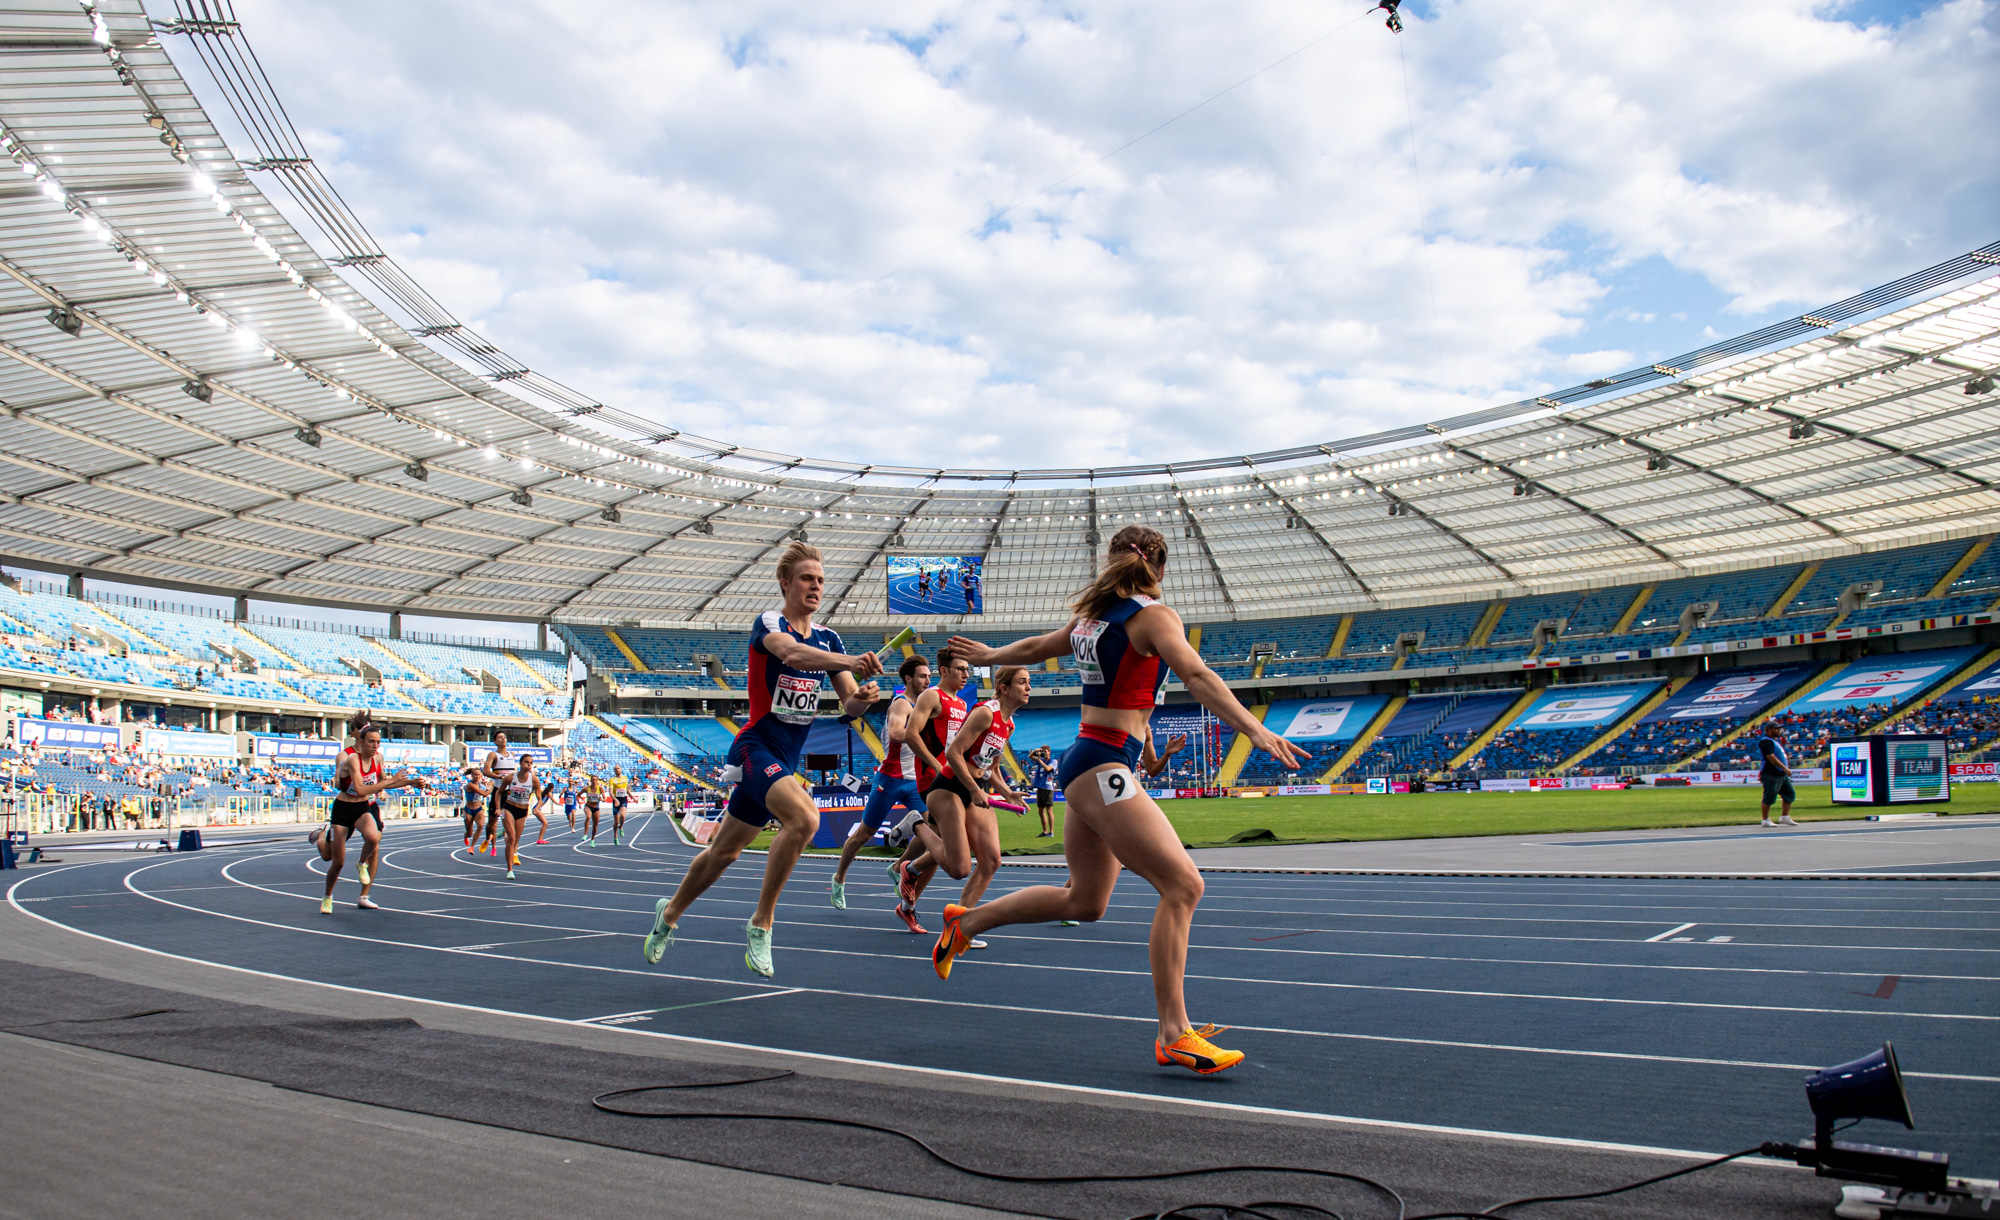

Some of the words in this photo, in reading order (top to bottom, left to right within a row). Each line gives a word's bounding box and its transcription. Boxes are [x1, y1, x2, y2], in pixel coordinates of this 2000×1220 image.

[1072, 636, 1096, 662] NOR
[780, 678, 814, 691] SPAR
[776, 689, 817, 710] NOR
[1840, 762, 1862, 775] TEAM
[1902, 760, 1934, 774] TEAM
[1955, 765, 1994, 775] SPAR
[847, 776, 857, 787] 7
[1108, 773, 1126, 799] 9
[1536, 780, 1562, 788] SPAR
[813, 797, 832, 808] Mixed
[840, 798, 844, 807] x
[845, 795, 863, 807] 400m
